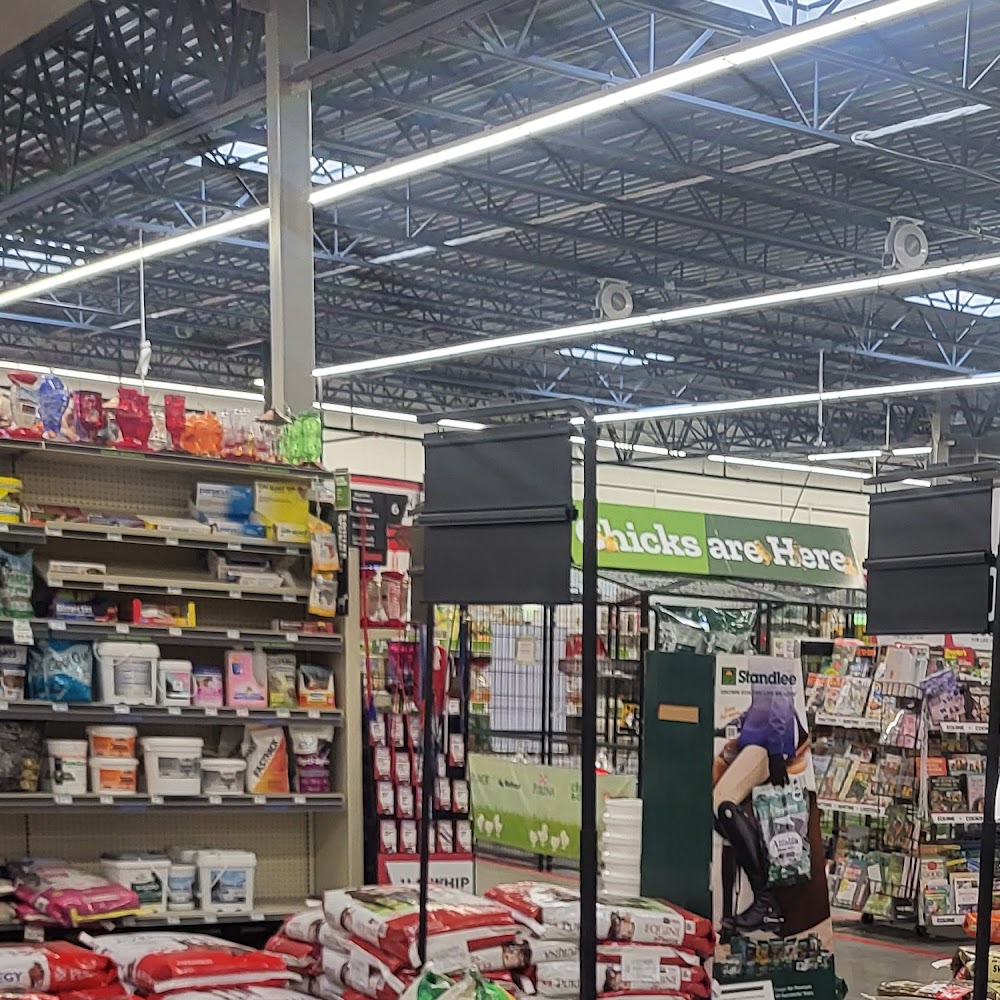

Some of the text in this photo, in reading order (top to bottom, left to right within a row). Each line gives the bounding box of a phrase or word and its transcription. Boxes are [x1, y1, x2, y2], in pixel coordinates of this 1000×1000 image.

[707, 537, 770, 564] are
[767, 535, 847, 572] Here
[738, 670, 797, 686] Standlee
